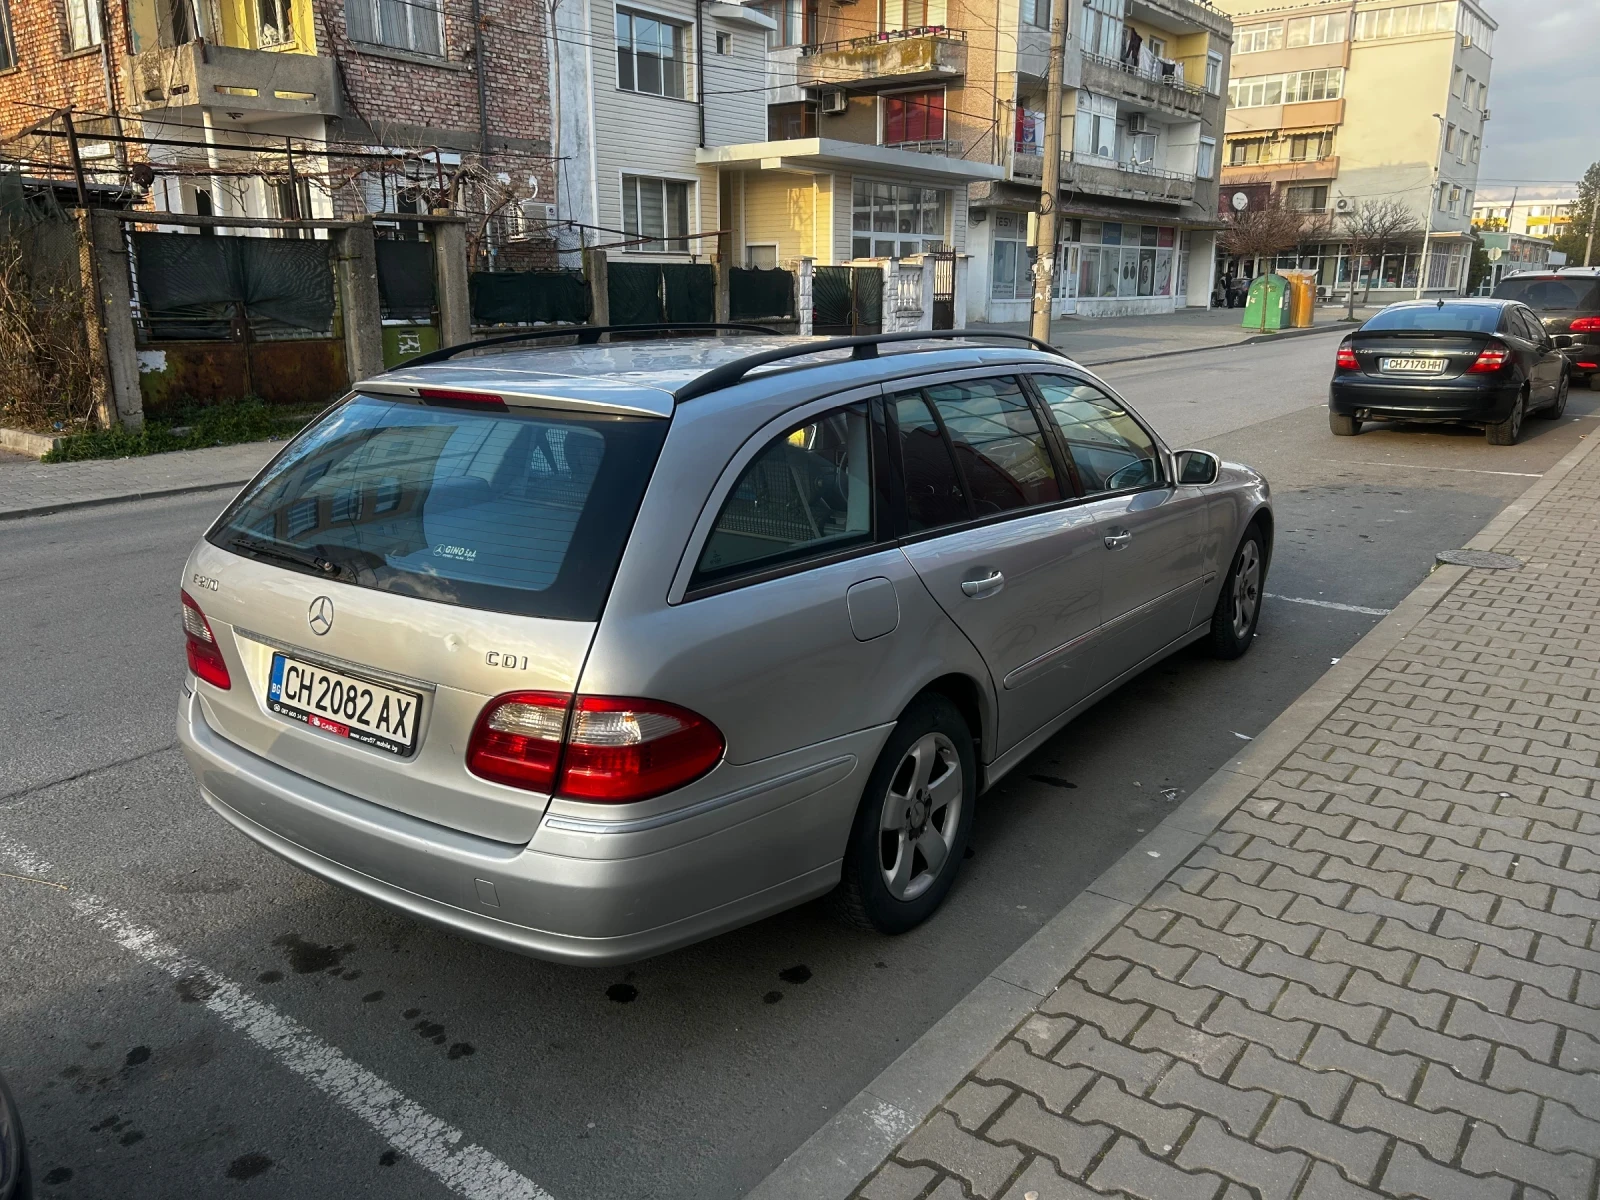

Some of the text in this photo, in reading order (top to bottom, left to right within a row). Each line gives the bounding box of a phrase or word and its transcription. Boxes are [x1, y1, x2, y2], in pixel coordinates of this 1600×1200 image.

[445, 546, 464, 556] GINO
[486, 650, 528, 670] CDI
[272, 683, 281, 694] BG
